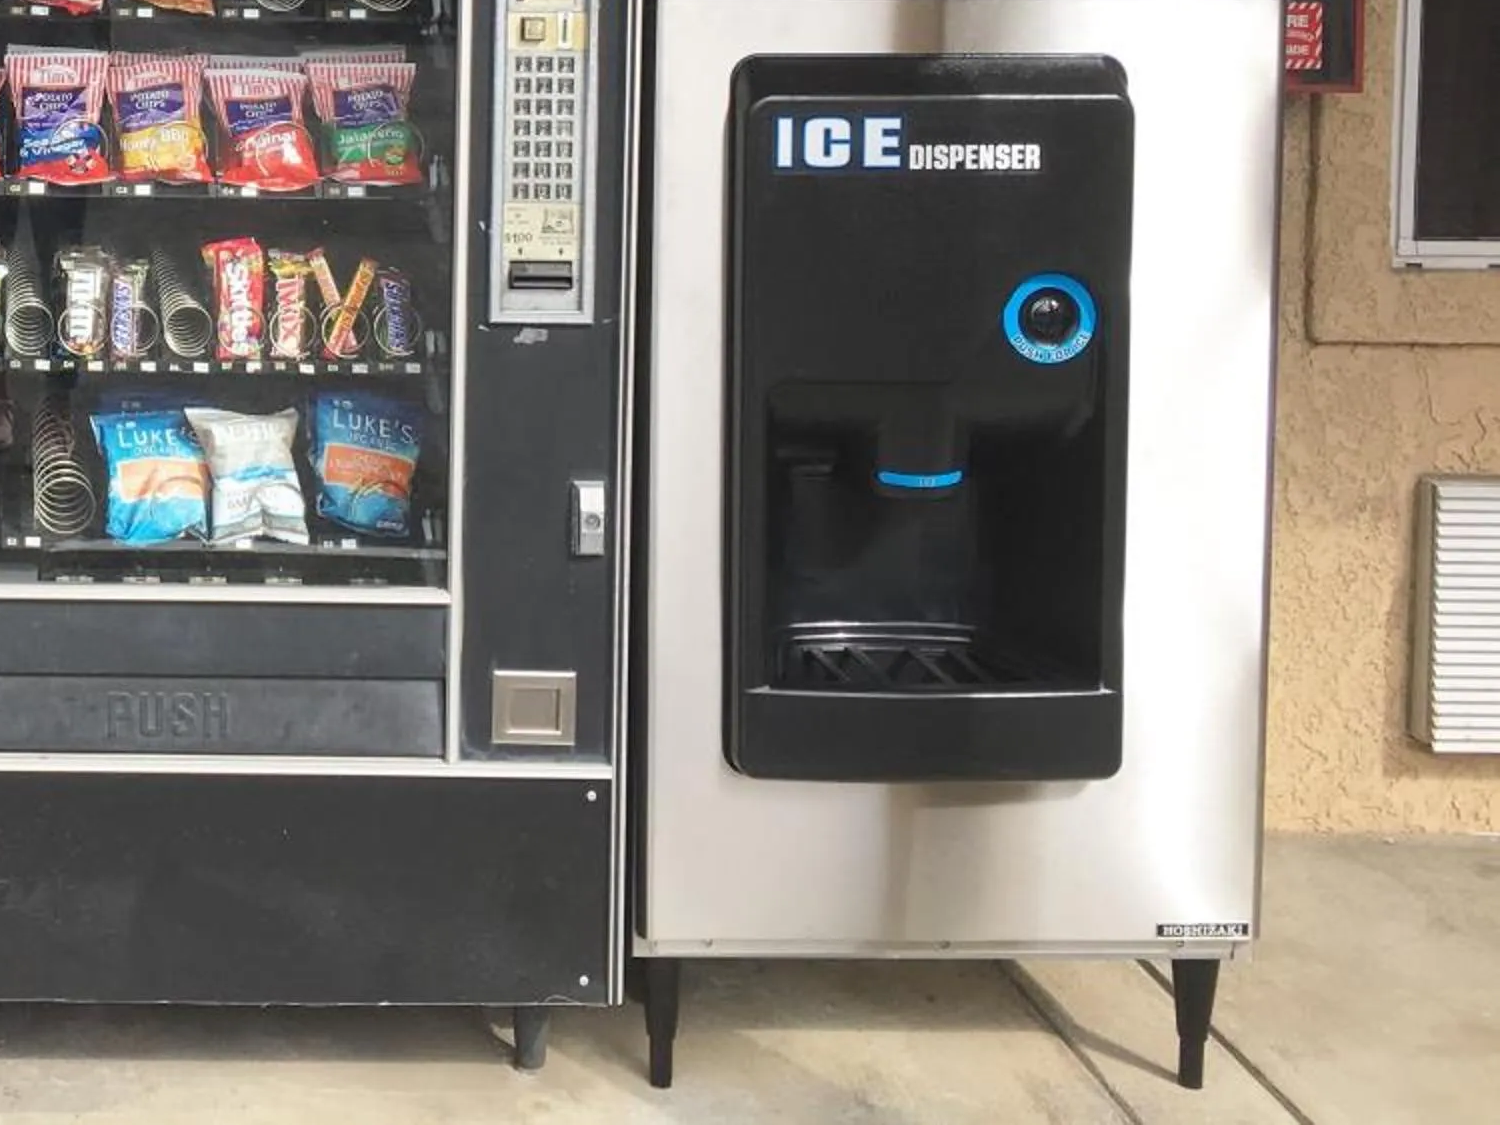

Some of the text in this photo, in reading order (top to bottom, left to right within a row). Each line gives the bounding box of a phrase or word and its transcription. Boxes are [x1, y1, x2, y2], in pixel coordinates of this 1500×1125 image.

[1286, 14, 1309, 28] RE
[776, 117, 1041, 171] ICE DISPENSER
[333, 408, 415, 445] LUKE'S
[106, 691, 230, 741] PUSH
